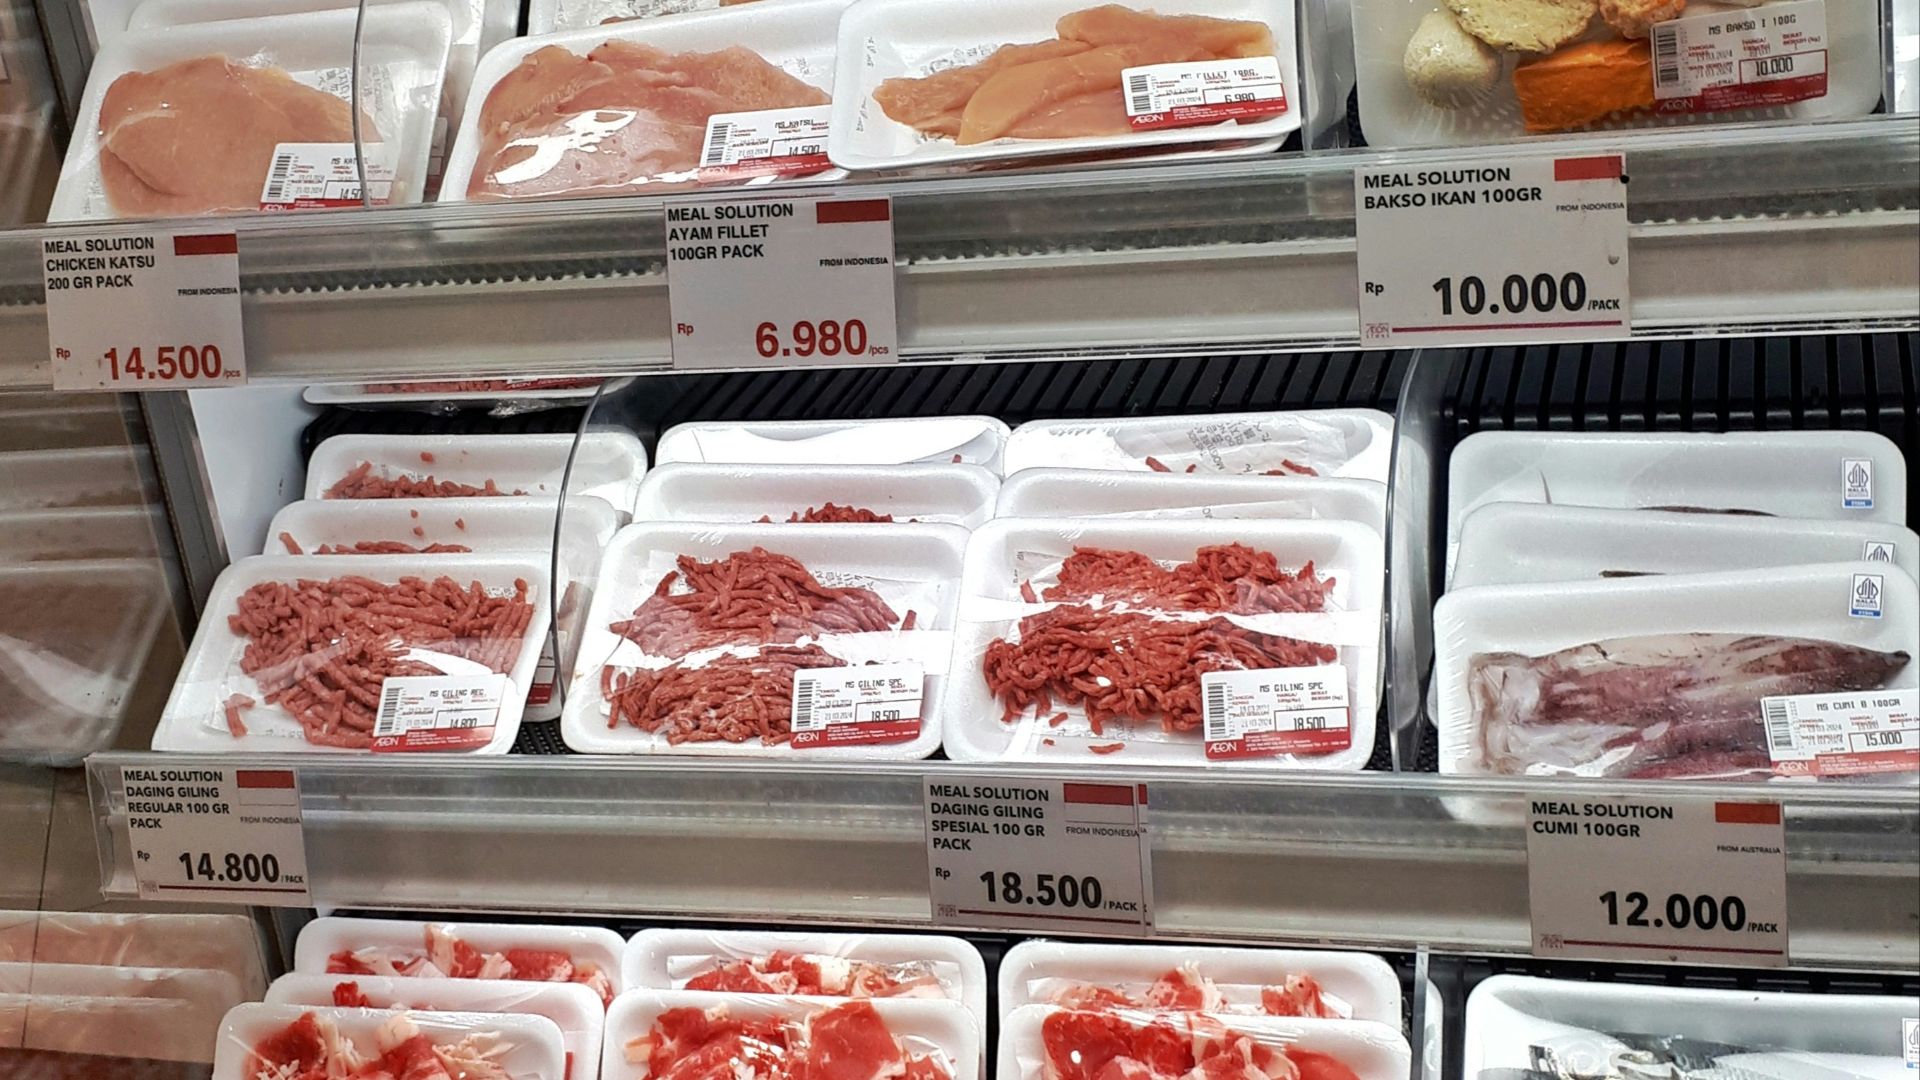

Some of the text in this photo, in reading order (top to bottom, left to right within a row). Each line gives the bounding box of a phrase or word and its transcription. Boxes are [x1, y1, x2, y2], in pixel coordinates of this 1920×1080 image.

[1708, 25, 1721, 35] MS
[1726, 21, 1756, 33] BAKSO
[1773, 15, 1796, 26] 100G
[1756, 57, 1793, 76] 10.000
[1225, 92, 1255, 104] 6980
[789, 145, 820, 156] 14500
[1364, 167, 1510, 188] MEAL SOLUTION
[1365, 187, 1542, 209] BAKSO IKAN 100GR
[667, 203, 793, 222] MEAL SOLUTION
[1556, 202, 1625, 212] FROM INDONESIA
[669, 224, 769, 241] AYAM FILLET
[45, 237, 155, 254] MEAL SOLUTION
[670, 244, 764, 261] 100GR PACK
[46, 255, 155, 272] CHICKEN KATSU
[820, 257, 888, 267] FROM INDONESIA
[48, 275, 134, 290] 200 GR PACK
[178, 287, 238, 296] FROM INDONESIA
[1365, 272, 1620, 315] Rp 10.000 /PACK
[677, 319, 889, 358] Rp 6.980 /pcs
[56, 344, 241, 381] Rp 14.500 /pcs
[1260, 685, 1270, 693] MS
[1308, 682, 1323, 690] SPC
[1817, 703, 1828, 711] MS
[1833, 701, 1855, 709] CUMI
[449, 718, 478, 728] 14800
[871, 710, 900, 722] 18500
[1293, 716, 1326, 731] 18500
[1865, 732, 1902, 746] 15.000
[124, 770, 223, 782] MEAL SOLUTION
[126, 786, 219, 798] DAGING GILING
[930, 784, 1049, 801] MEAL SOLUTION
[128, 802, 230, 814] REGULAR 100 GR
[931, 803, 1044, 819] DAGING GILING
[1532, 802, 1673, 819] MEAL SOLUTION
[130, 818, 162, 829] PACK
[932, 820, 1045, 837] SPESIAL 100 GR
[1066, 826, 1090, 835] FROM
[1092, 827, 1139, 837] INDONESIA
[1533, 821, 1640, 838] CUMI 100GR
[933, 838, 972, 851] PACK
[1717, 845, 1781, 854] FROM AUSTRALIA
[137, 850, 150, 862] Rp
[179, 852, 280, 883] 14.800
[935, 867, 950, 880] Rp
[980, 870, 1102, 909] 18.500
[1599, 890, 1778, 934] 12.000 /PACK
